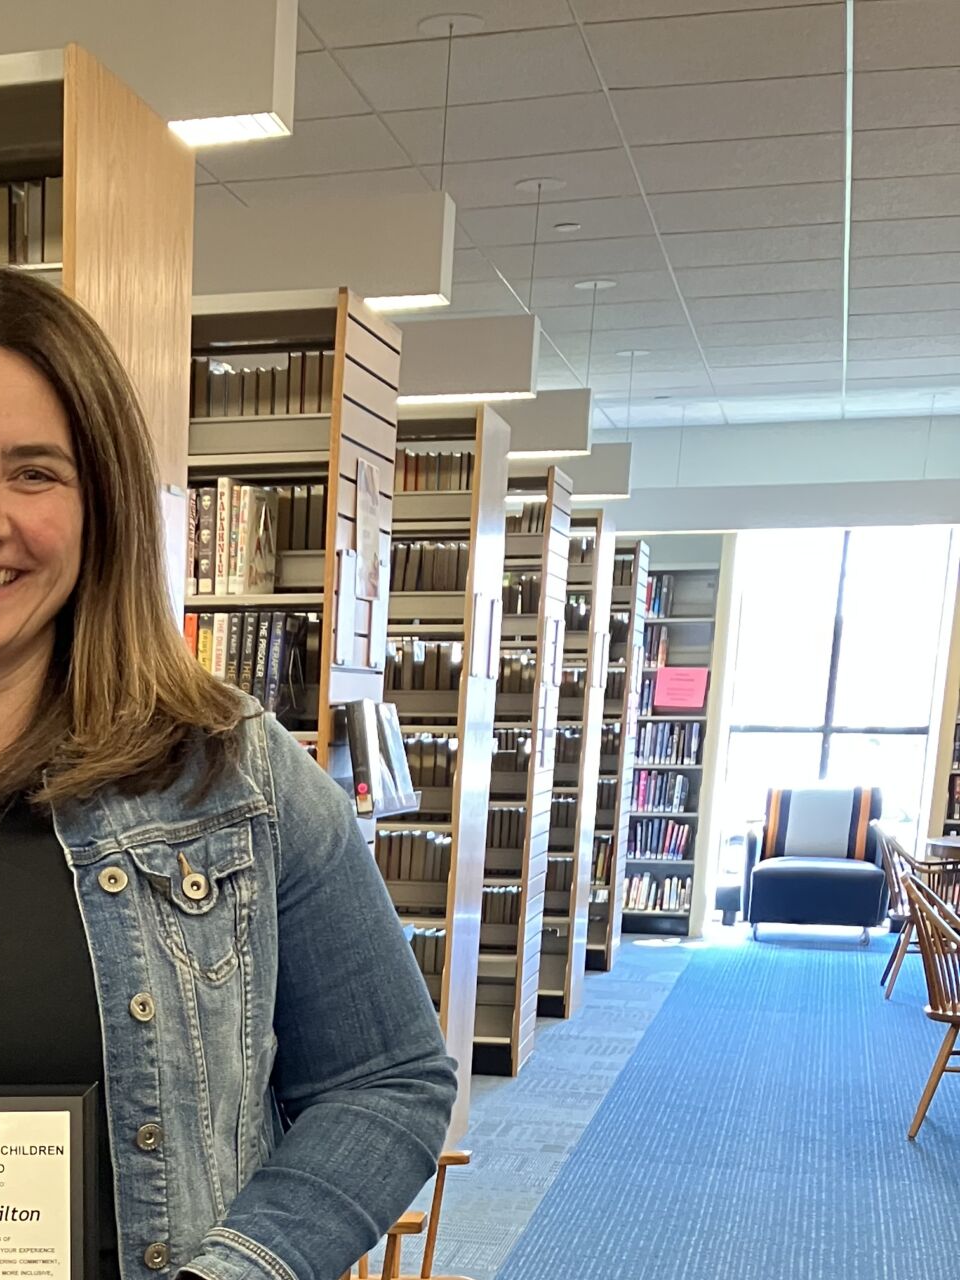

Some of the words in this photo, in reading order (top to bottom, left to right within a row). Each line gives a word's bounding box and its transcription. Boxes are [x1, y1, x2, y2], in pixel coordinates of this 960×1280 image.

[259, 621, 268, 637] THE
[275, 621, 283, 636] THE
[256, 638, 267, 678] PRISONER
[227, 659, 237, 680] THE
[242, 659, 252, 680] THE
[0, 1145, 64, 1156] CHILDREN
